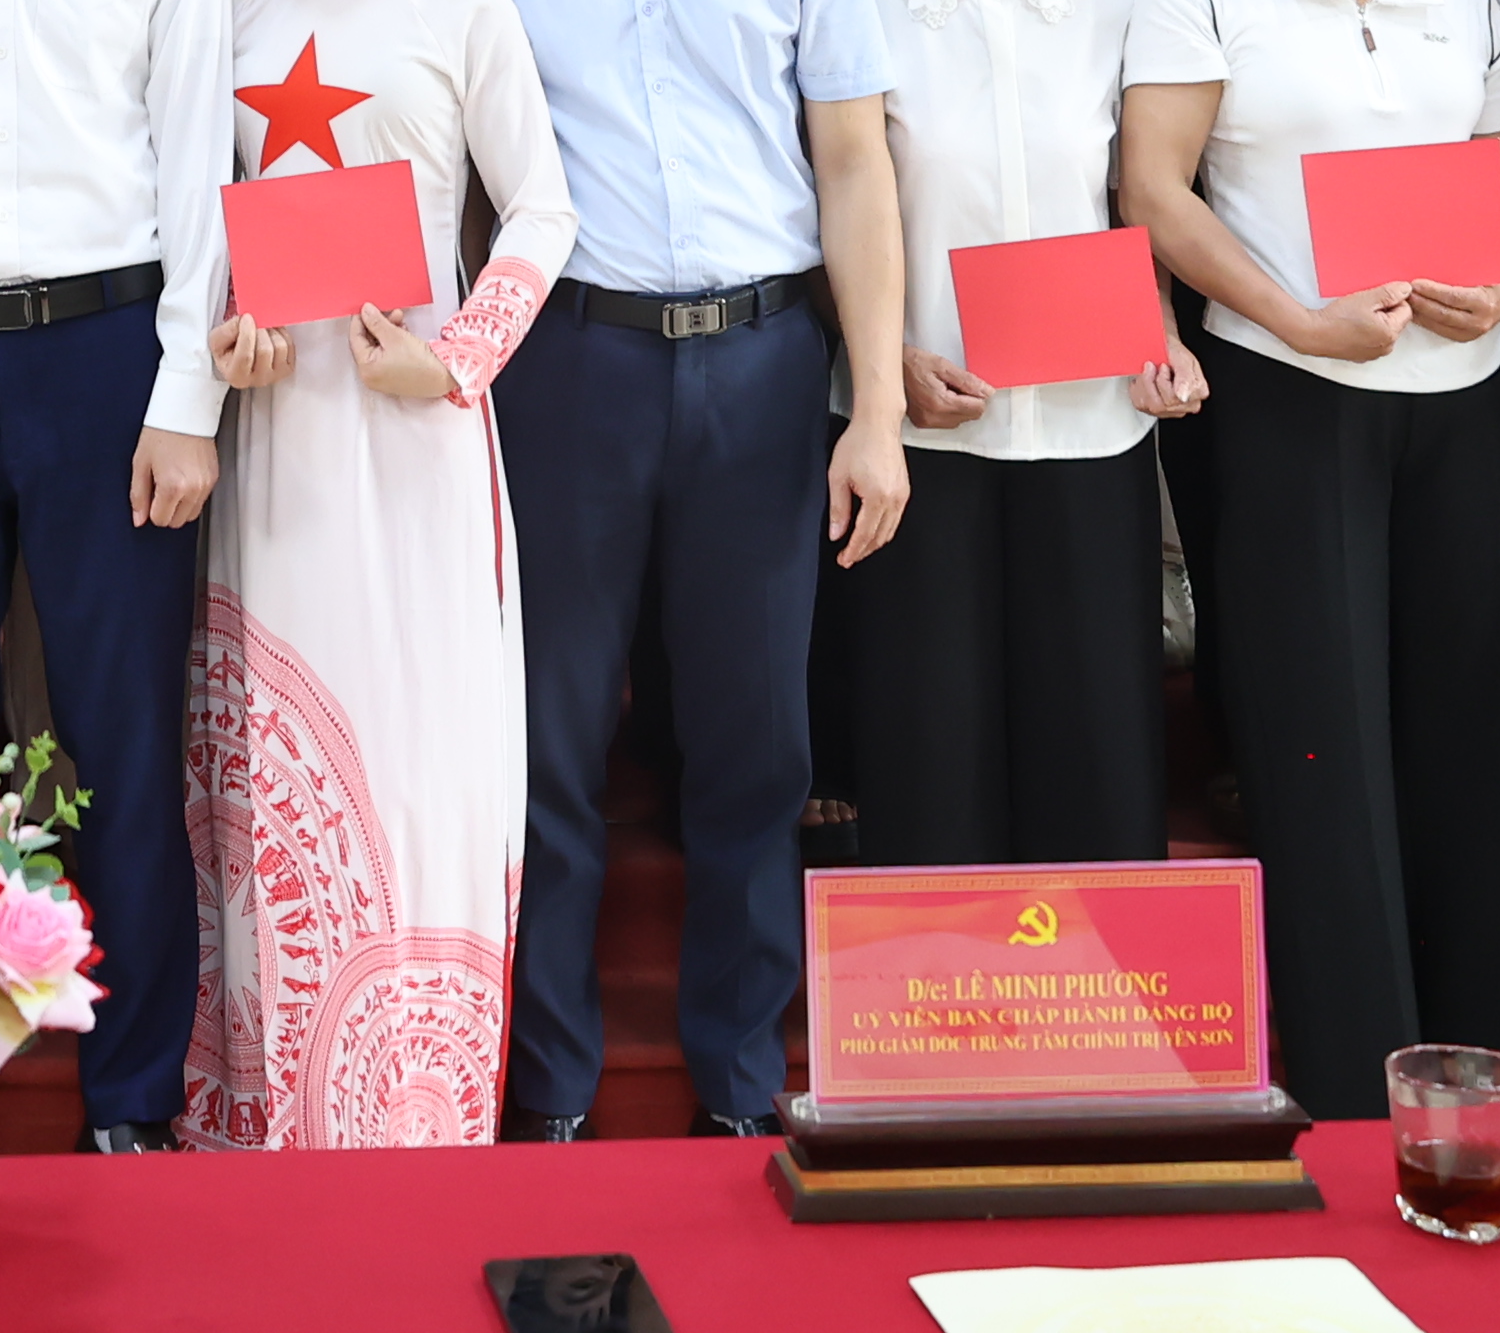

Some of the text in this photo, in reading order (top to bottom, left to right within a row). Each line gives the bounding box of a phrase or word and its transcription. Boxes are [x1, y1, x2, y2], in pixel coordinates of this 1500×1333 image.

[954, 968, 985, 1001] LÊ
[992, 974, 1058, 1001] MINH
[1064, 968, 1168, 999] PHƯƠNG
[888, 1005, 942, 1027] VIÊN
[948, 1009, 993, 1027] BAN
[996, 1003, 1060, 1026] CHẤP
[1063, 1001, 1127, 1025] HÀNH
[1201, 1000, 1234, 1024] BỘ
[879, 1032, 925, 1053] GIÁM
[970, 1034, 1027, 1051] TRUNG
[1033, 1029, 1069, 1050] TÂM
[1072, 1029, 1127, 1049] CHÍNH
[1132, 1031, 1161, 1051] TRỊ
[1164, 1025, 1197, 1048] YÊN
[1200, 1028, 1235, 1045] SƠN
